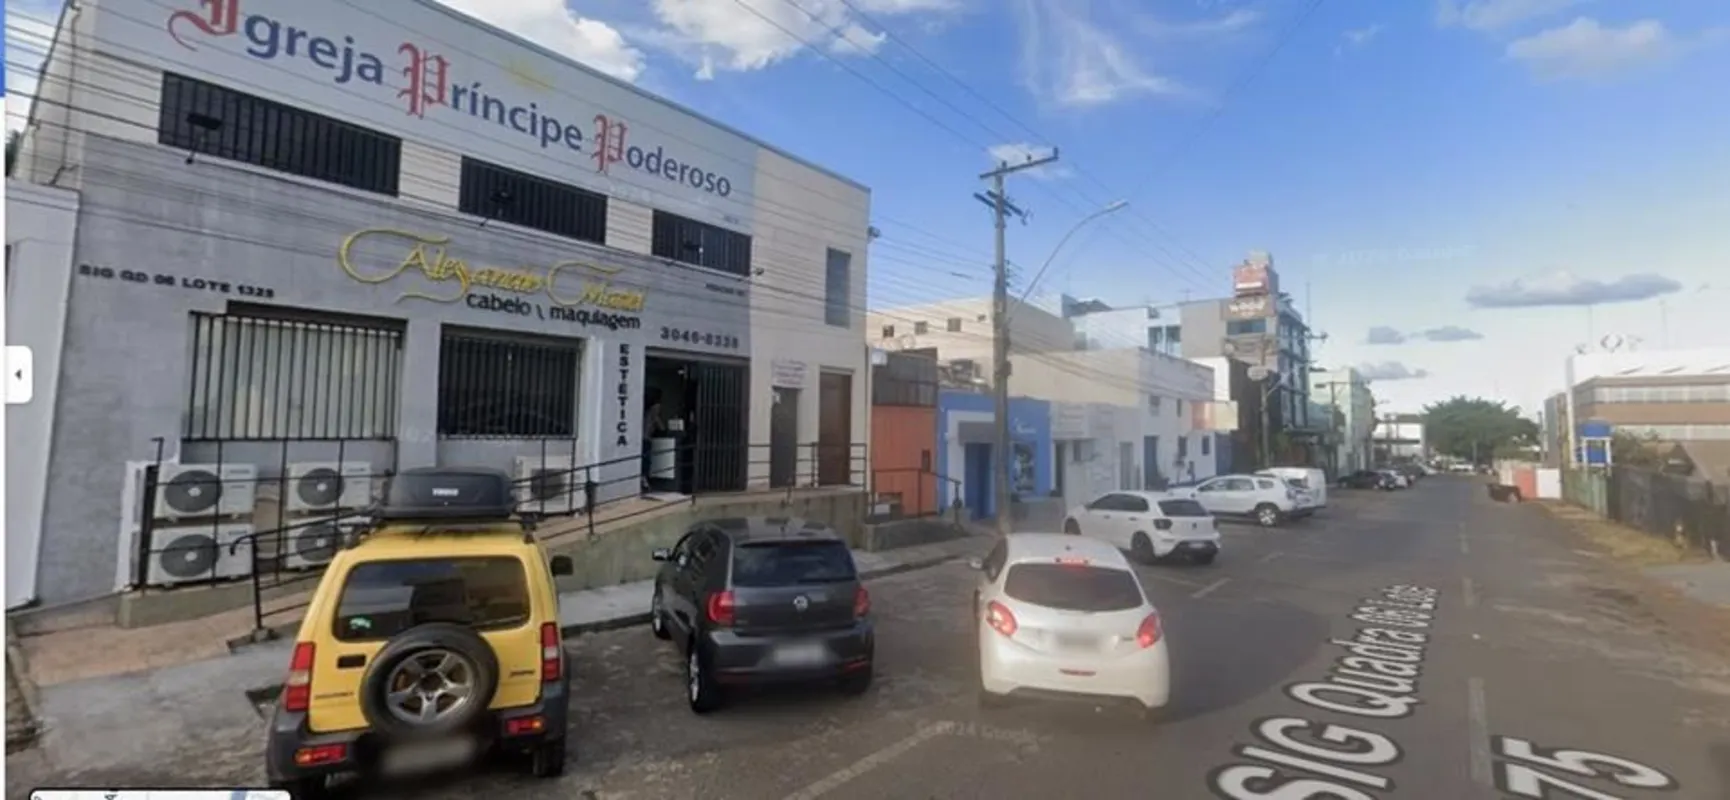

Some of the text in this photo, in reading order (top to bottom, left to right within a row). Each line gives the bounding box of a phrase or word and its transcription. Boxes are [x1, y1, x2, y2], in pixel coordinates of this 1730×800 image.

[397, 42, 583, 151] Príncipe
[590, 113, 732, 198] Poderoso
[180, 276, 232, 294] LOTE
[466, 291, 532, 317] cabelo
[550, 305, 642, 332] maquiagem
